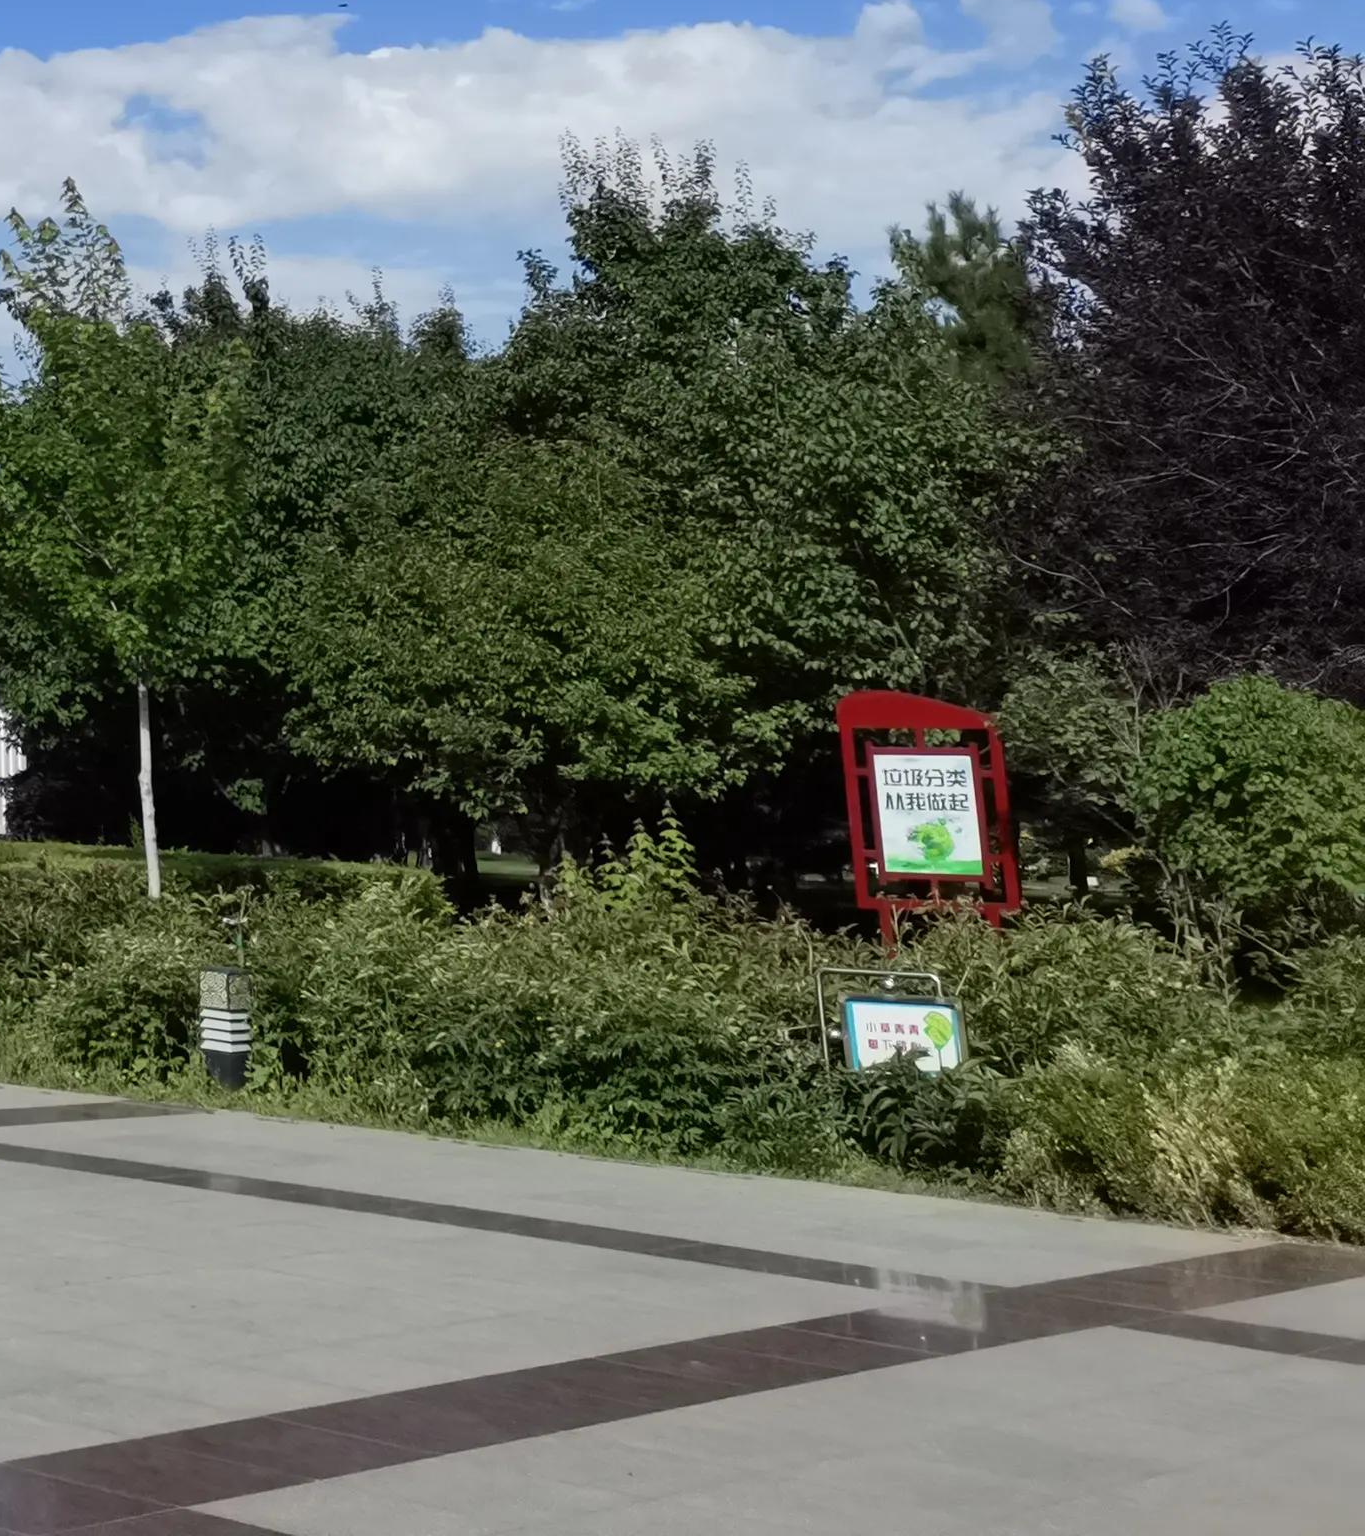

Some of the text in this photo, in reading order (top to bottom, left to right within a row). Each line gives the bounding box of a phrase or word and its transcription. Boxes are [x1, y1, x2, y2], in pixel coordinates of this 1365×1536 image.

[882, 768, 968, 788] 垃圾分类
[884, 791, 970, 812] 从我做起
